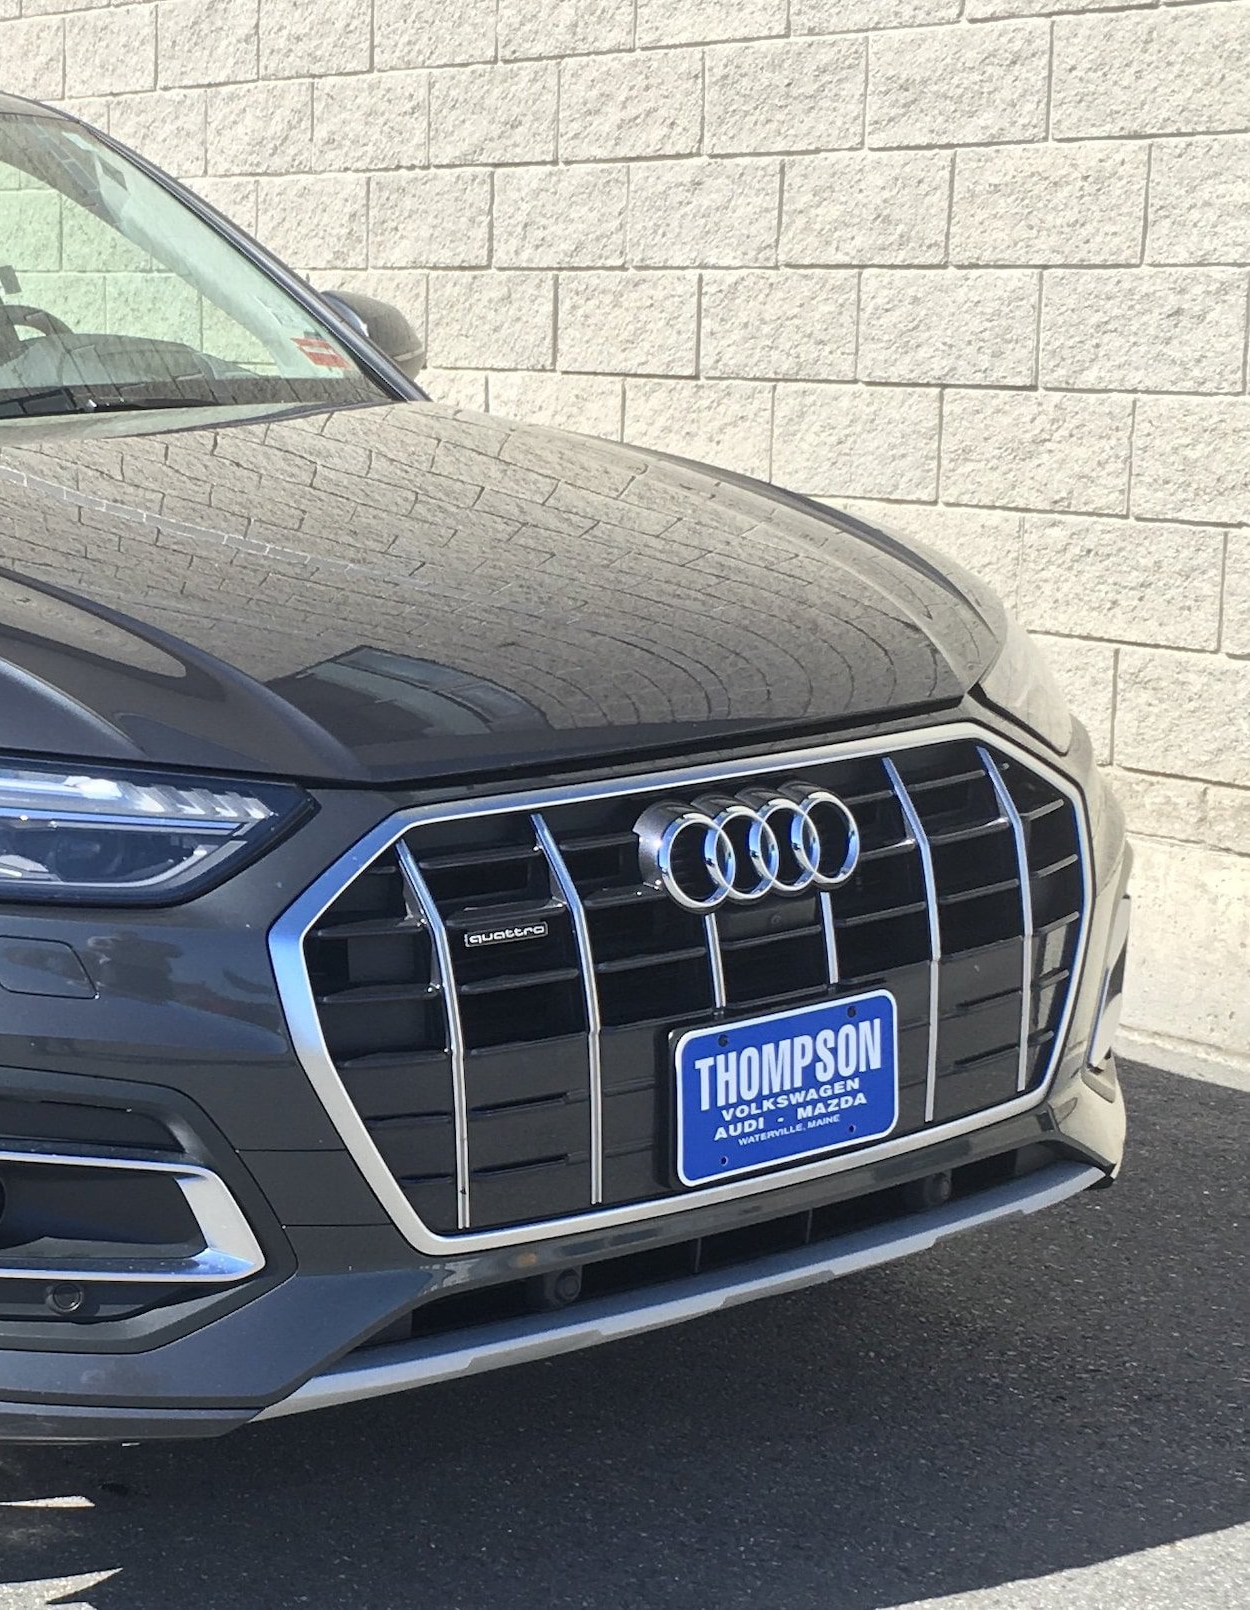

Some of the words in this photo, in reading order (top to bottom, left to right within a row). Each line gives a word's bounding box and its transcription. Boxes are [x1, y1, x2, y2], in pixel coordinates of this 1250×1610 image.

[469, 925, 546, 944] quattro
[694, 1017, 882, 1111] THOMPSON
[713, 1116, 765, 1142] AUDI
[796, 1093, 868, 1121] MAZDA
[721, 1077, 860, 1122] VOLKSWAGEN
[807, 1114, 840, 1130] MAINE
